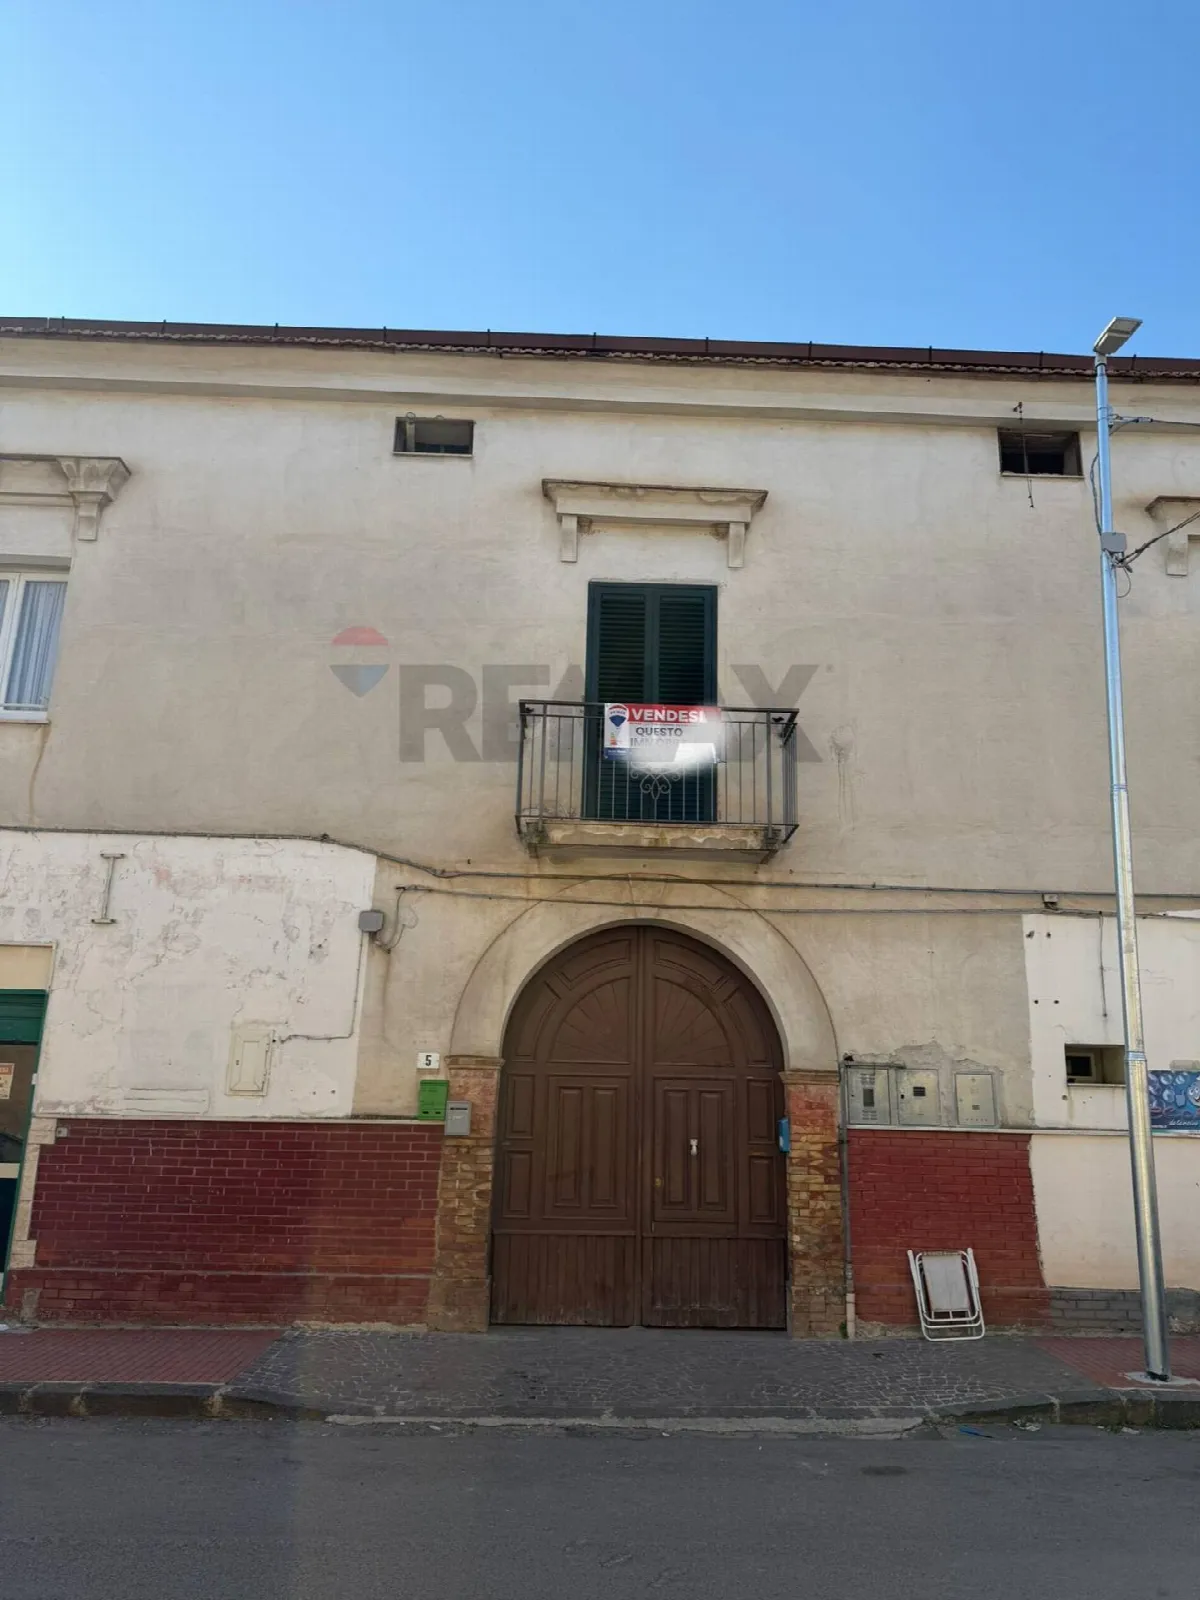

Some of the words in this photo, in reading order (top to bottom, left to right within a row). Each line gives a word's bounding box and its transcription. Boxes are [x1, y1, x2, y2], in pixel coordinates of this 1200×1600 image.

[631, 708, 706, 723] VENDESI
[636, 727, 683, 738] QUESTO
[425, 1054, 432, 1067] 5
